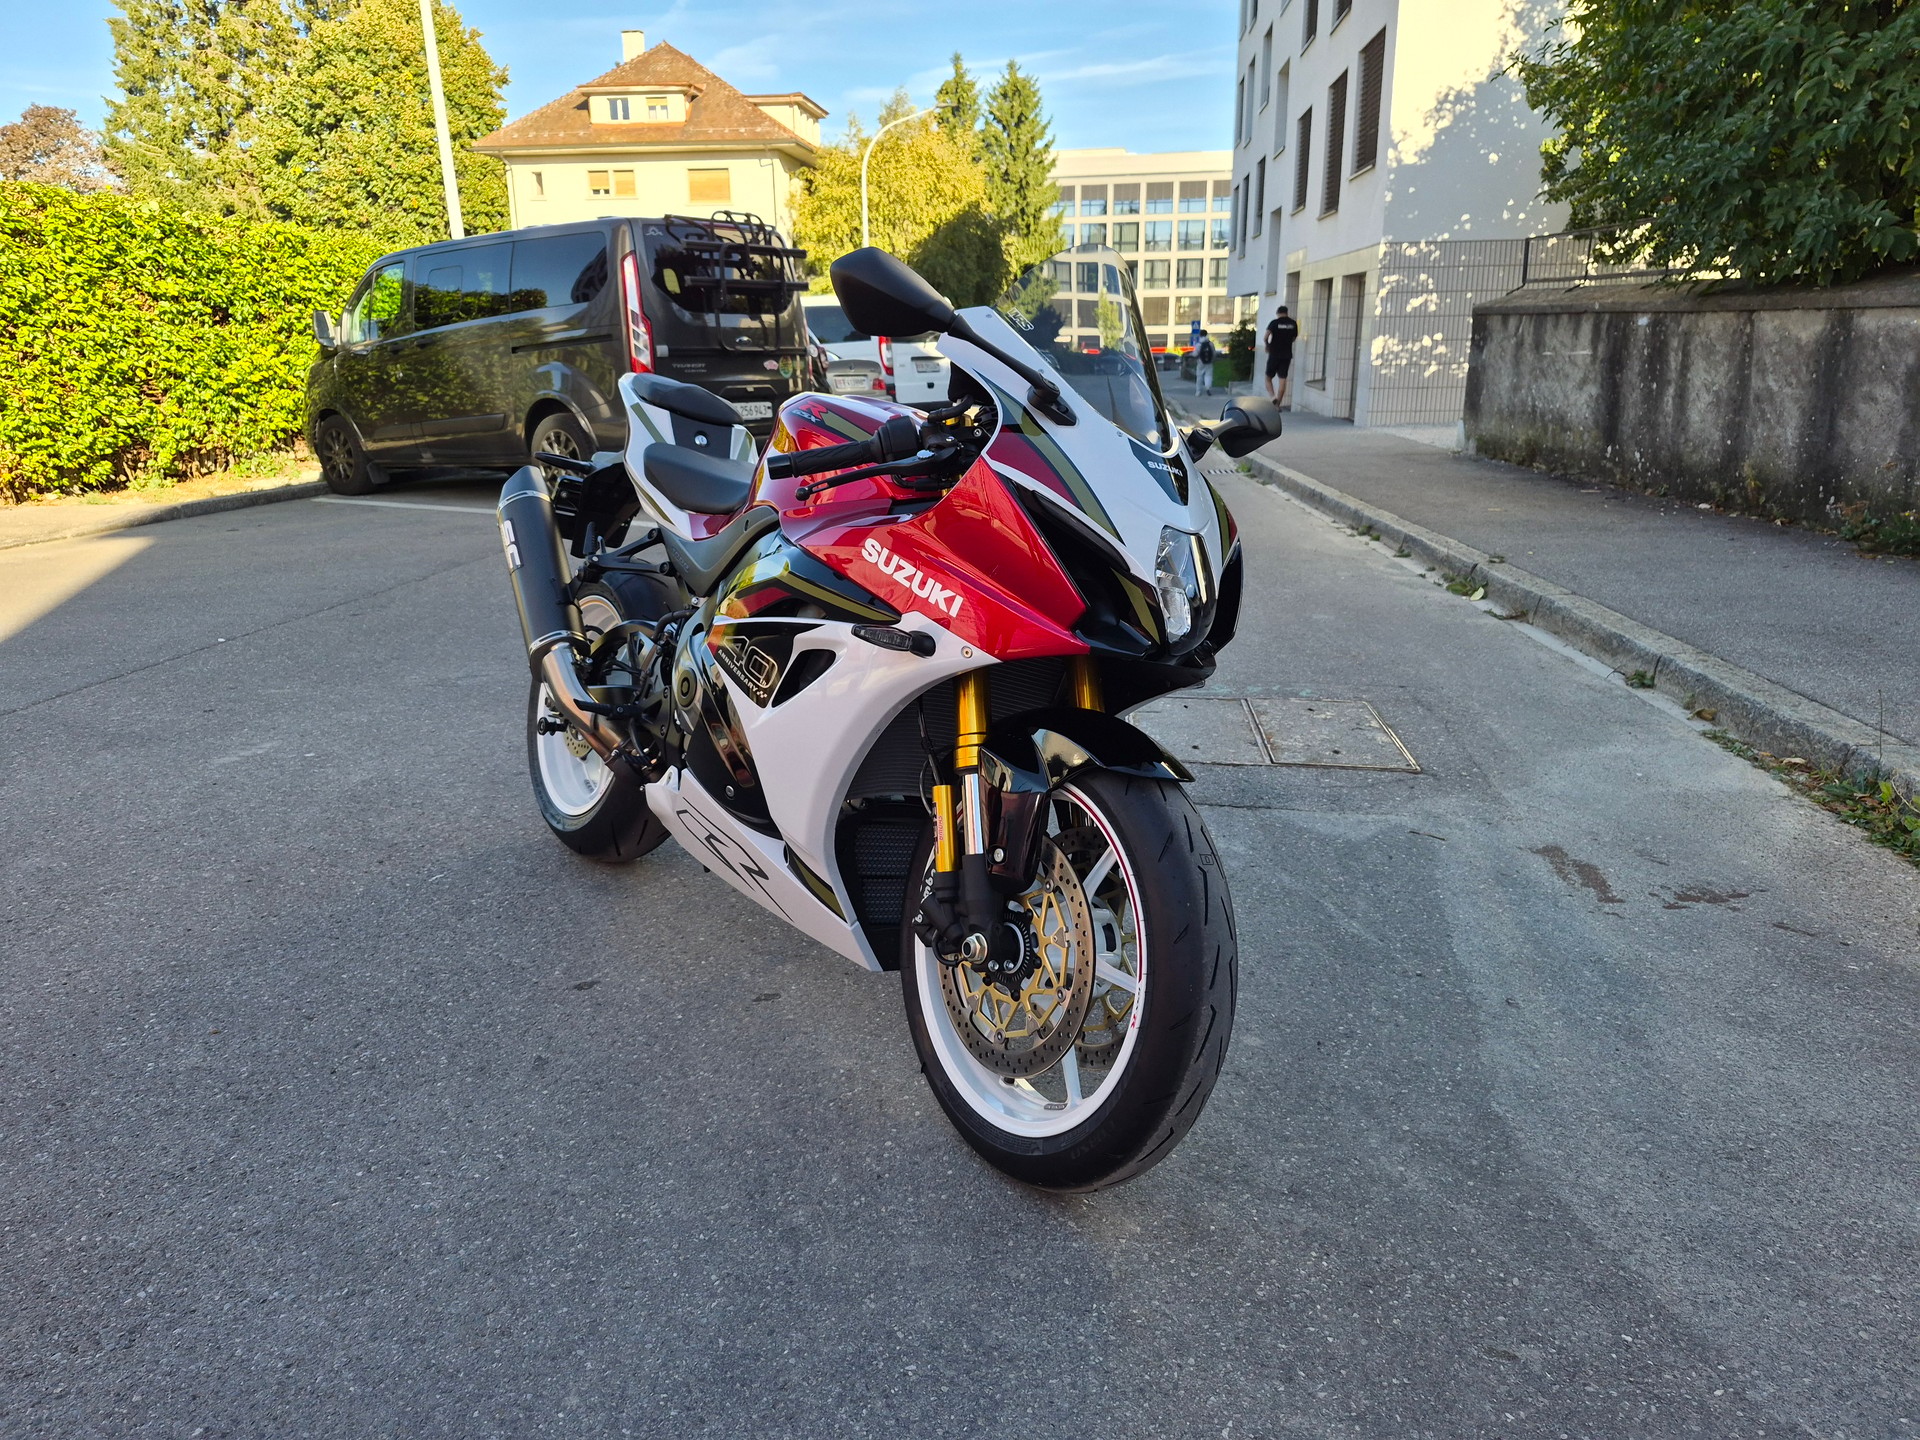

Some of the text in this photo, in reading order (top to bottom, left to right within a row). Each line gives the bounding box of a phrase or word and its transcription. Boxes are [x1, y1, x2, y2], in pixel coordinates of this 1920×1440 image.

[1147, 460, 1184, 477] SUZUKI
[861, 538, 964, 618] SUZUKI
[717, 649, 759, 692] ANNIVERSARY
